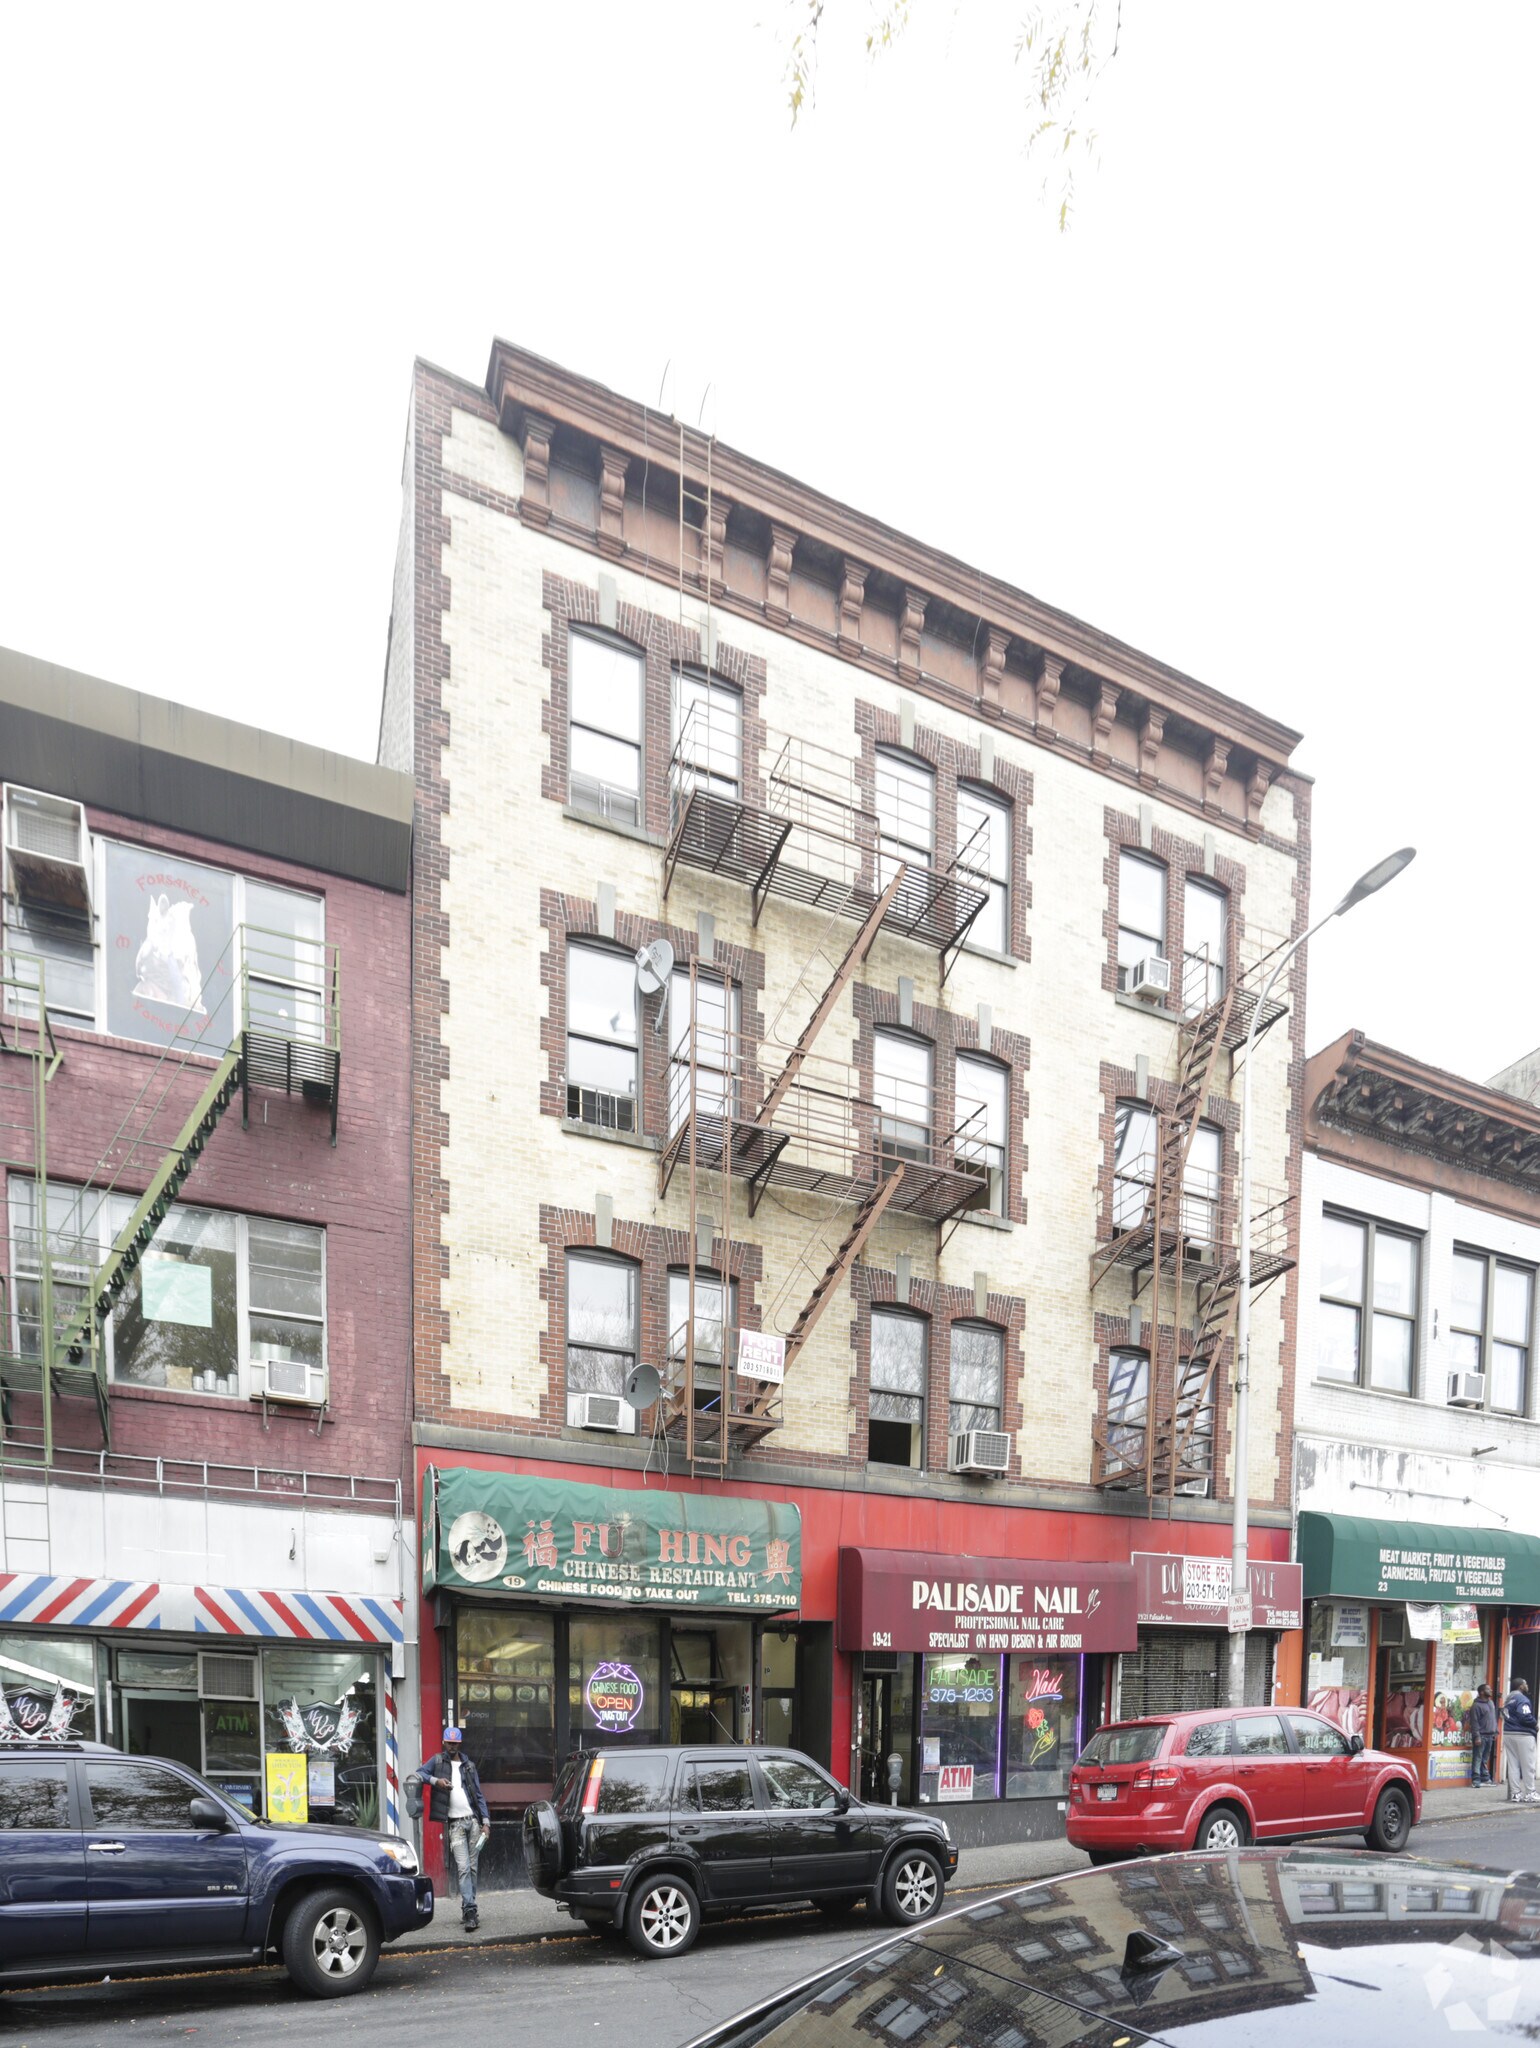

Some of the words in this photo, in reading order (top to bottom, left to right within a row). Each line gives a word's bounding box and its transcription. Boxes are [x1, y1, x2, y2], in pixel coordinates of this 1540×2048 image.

[748, 1335, 777, 1352] FOR
[742, 1345, 781, 1364] RENT
[521, 1519, 559, 1570] 福
[571, 1520, 625, 1558] FU
[658, 1528, 752, 1567] HING
[1380, 1549, 1400, 1563] MEAT
[1401, 1551, 1432, 1568] MARKET,
[1433, 1553, 1454, 1567] FRUIT
[1455, 1555, 1461, 1568] &
[1462, 1555, 1505, 1570] VEGETABLES
[507, 1577, 521, 1586] 19
[563, 1559, 641, 1582] CHINESE
[648, 1566, 758, 1589] RESTAURANT
[1187, 1563, 1211, 1582] STORE
[1216, 1564, 1233, 1583] REN
[1381, 1565, 1427, 1584] CARNICERIA,
[1429, 1568, 1456, 1583] FRUTAS
[1457, 1570, 1463, 1583] Y
[1464, 1570, 1503, 1585] VEGETALES
[537, 1579, 588, 1594] CHINESE
[590, 1583, 622, 1596] FOOD
[624, 1586, 641, 1597] TO
[645, 1587, 673, 1599] TAKE
[676, 1589, 699, 1600] OUT
[727, 1592, 751, 1603] TEL:
[753, 1594, 797, 1606] 375-7110
[1377, 1581, 1388, 1592] 23
[912, 1580, 1024, 1613] PALISADE
[1034, 1586, 1083, 1614] NAIL
[954, 1615, 1020, 1630] PROFFESIONAL
[1021, 1616, 1041, 1631] NAIL
[1042, 1617, 1065, 1631] CARE
[872, 1631, 892, 1647] 19-21
[928, 1632, 970, 1649] SPECIALIST
[975, 1633, 987, 1649] ON
[989, 1633, 1009, 1649] HAND
[1011, 1633, 1036, 1649] DESIGN
[1037, 1634, 1044, 1649] &
[1045, 1634, 1058, 1649] AIR
[1060, 1634, 1082, 1649] BRUSH
[930, 1668, 995, 1686] PALISADE
[1025, 1669, 1063, 1699] Nail
[592, 1681, 619, 1694] CHINESE
[620, 1682, 639, 1695] FOOD
[930, 1687, 994, 1703] 375-1253
[10, 1696, 47, 1729] MVP
[596, 1696, 633, 1711] OPEN
[216, 1715, 249, 1732] ATM
[304, 1709, 335, 1739] MVP
[940, 1767, 972, 1789] ATM
